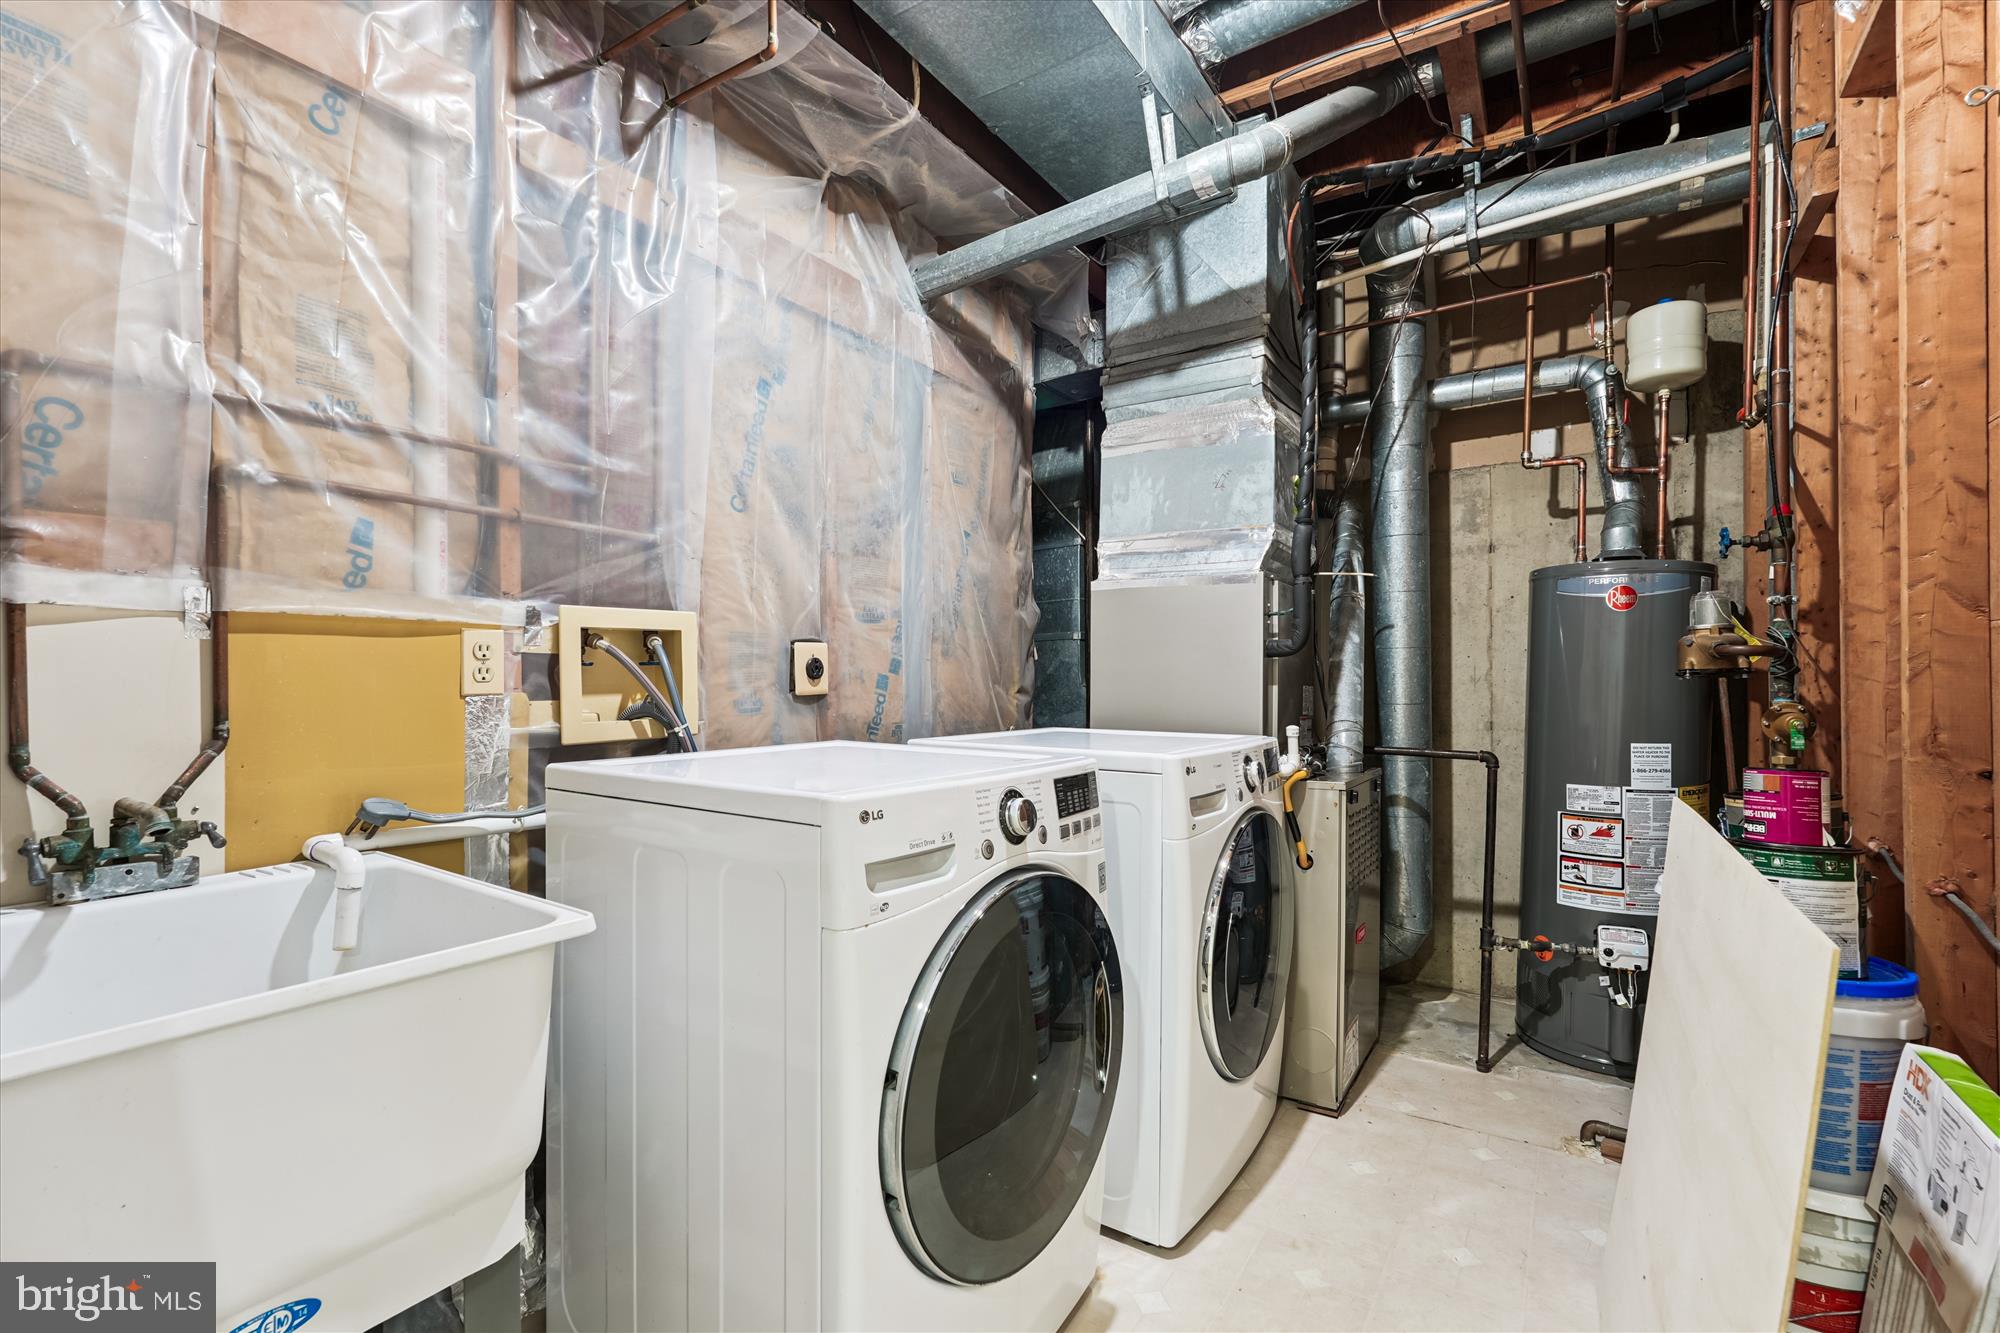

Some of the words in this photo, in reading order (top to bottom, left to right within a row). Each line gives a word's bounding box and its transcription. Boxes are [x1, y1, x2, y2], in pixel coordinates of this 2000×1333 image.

[1609, 585, 1637, 607] Rheem
[1191, 766, 1196, 774] LG
[872, 810, 883, 820] LG
[909, 841, 923, 850] Direct
[924, 839, 936, 848] Drive
[1907, 1059, 1932, 1101] HDX
